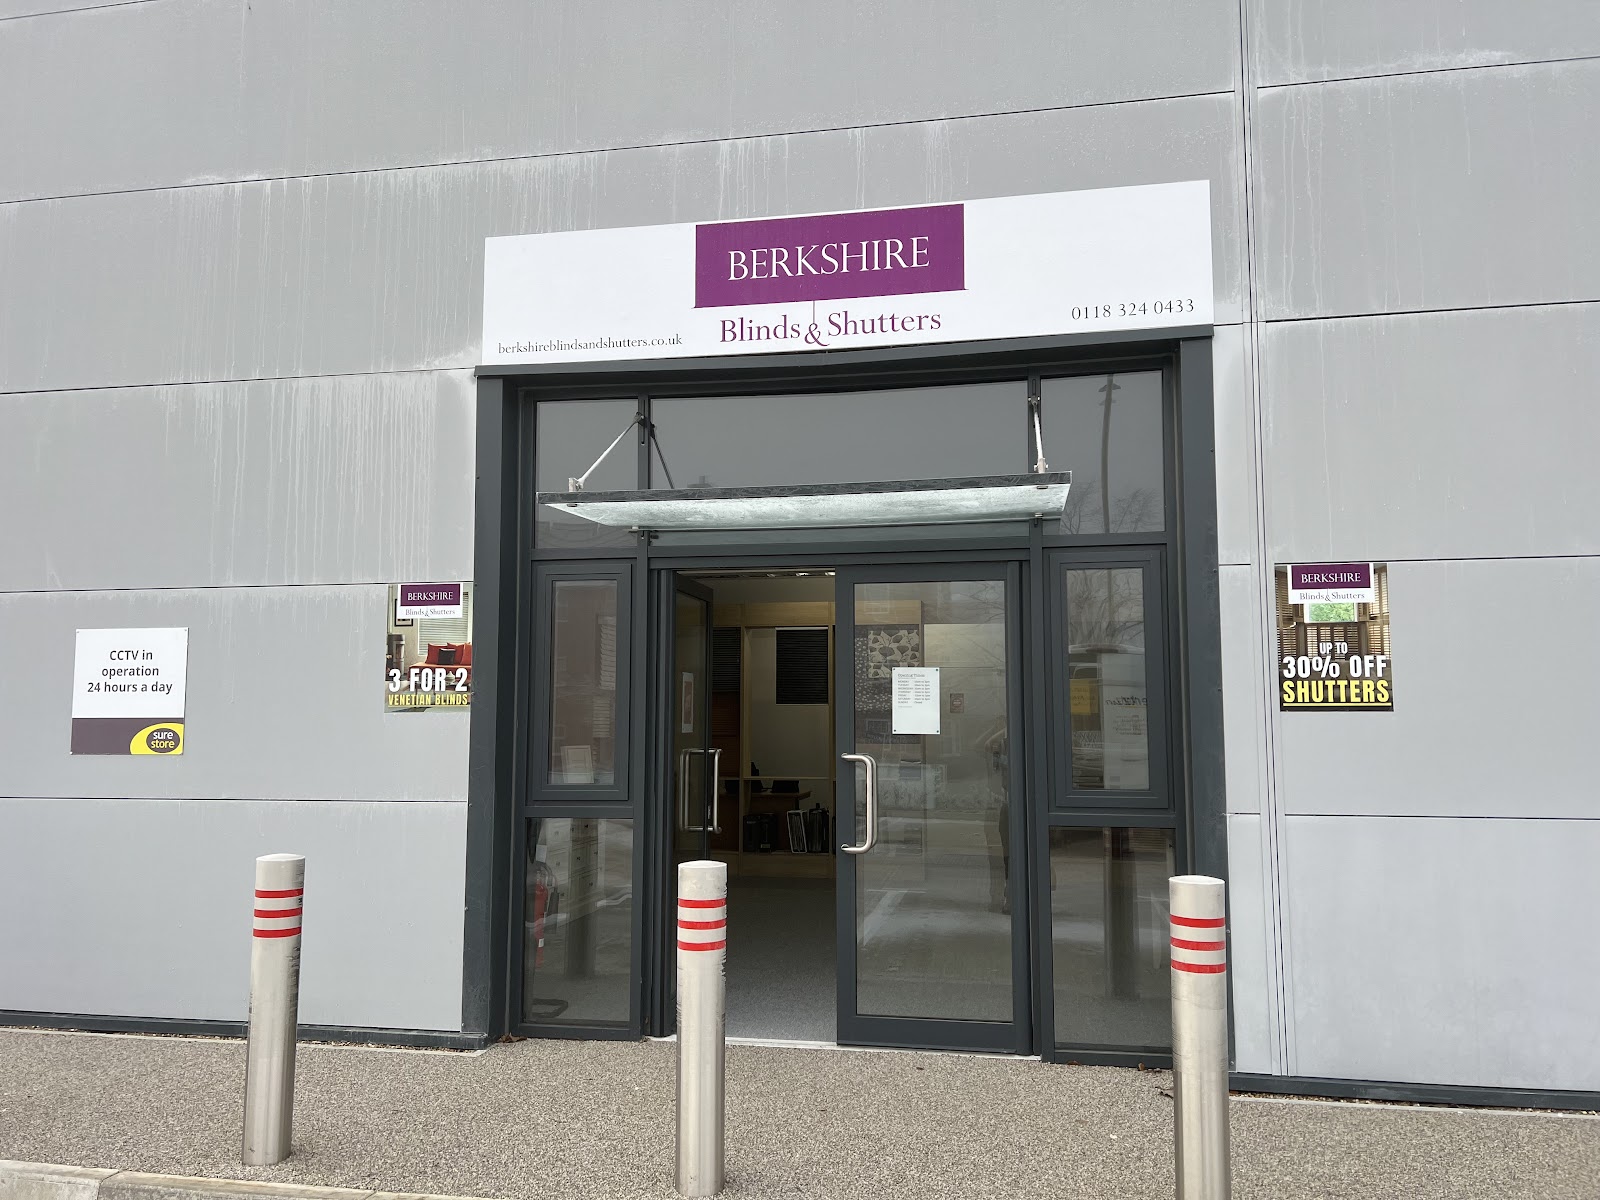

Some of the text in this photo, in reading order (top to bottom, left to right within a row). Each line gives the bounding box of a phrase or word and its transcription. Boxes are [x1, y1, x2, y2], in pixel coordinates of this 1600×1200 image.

[728, 236, 930, 281] BERKSHIRE
[1071, 298, 1195, 320] 0118 324 0433
[720, 311, 942, 347] Blinds & Shutters
[498, 333, 683, 354] berkshireblindsandshutters.co.uk
[1301, 572, 1361, 583] BERKSHIRE
[407, 591, 454, 601] BERKSHIRE
[1299, 592, 1324, 600] Blinds
[1331, 591, 1365, 600] Shutters
[405, 608, 424, 616] Blinds
[1319, 641, 1348, 654] UP TO
[109, 649, 153, 661] CCTV in
[101, 665, 159, 679] operation
[1282, 655, 1387, 678] 30% OFF
[388, 667, 468, 692] 3 FOR 2
[87, 681, 173, 695] 24 hours a day
[1282, 679, 1389, 703] SHUTTERS
[388, 693, 468, 706] VENETIAN BLINDS
[153, 731, 174, 740] sure
[151, 739, 175, 749] store
